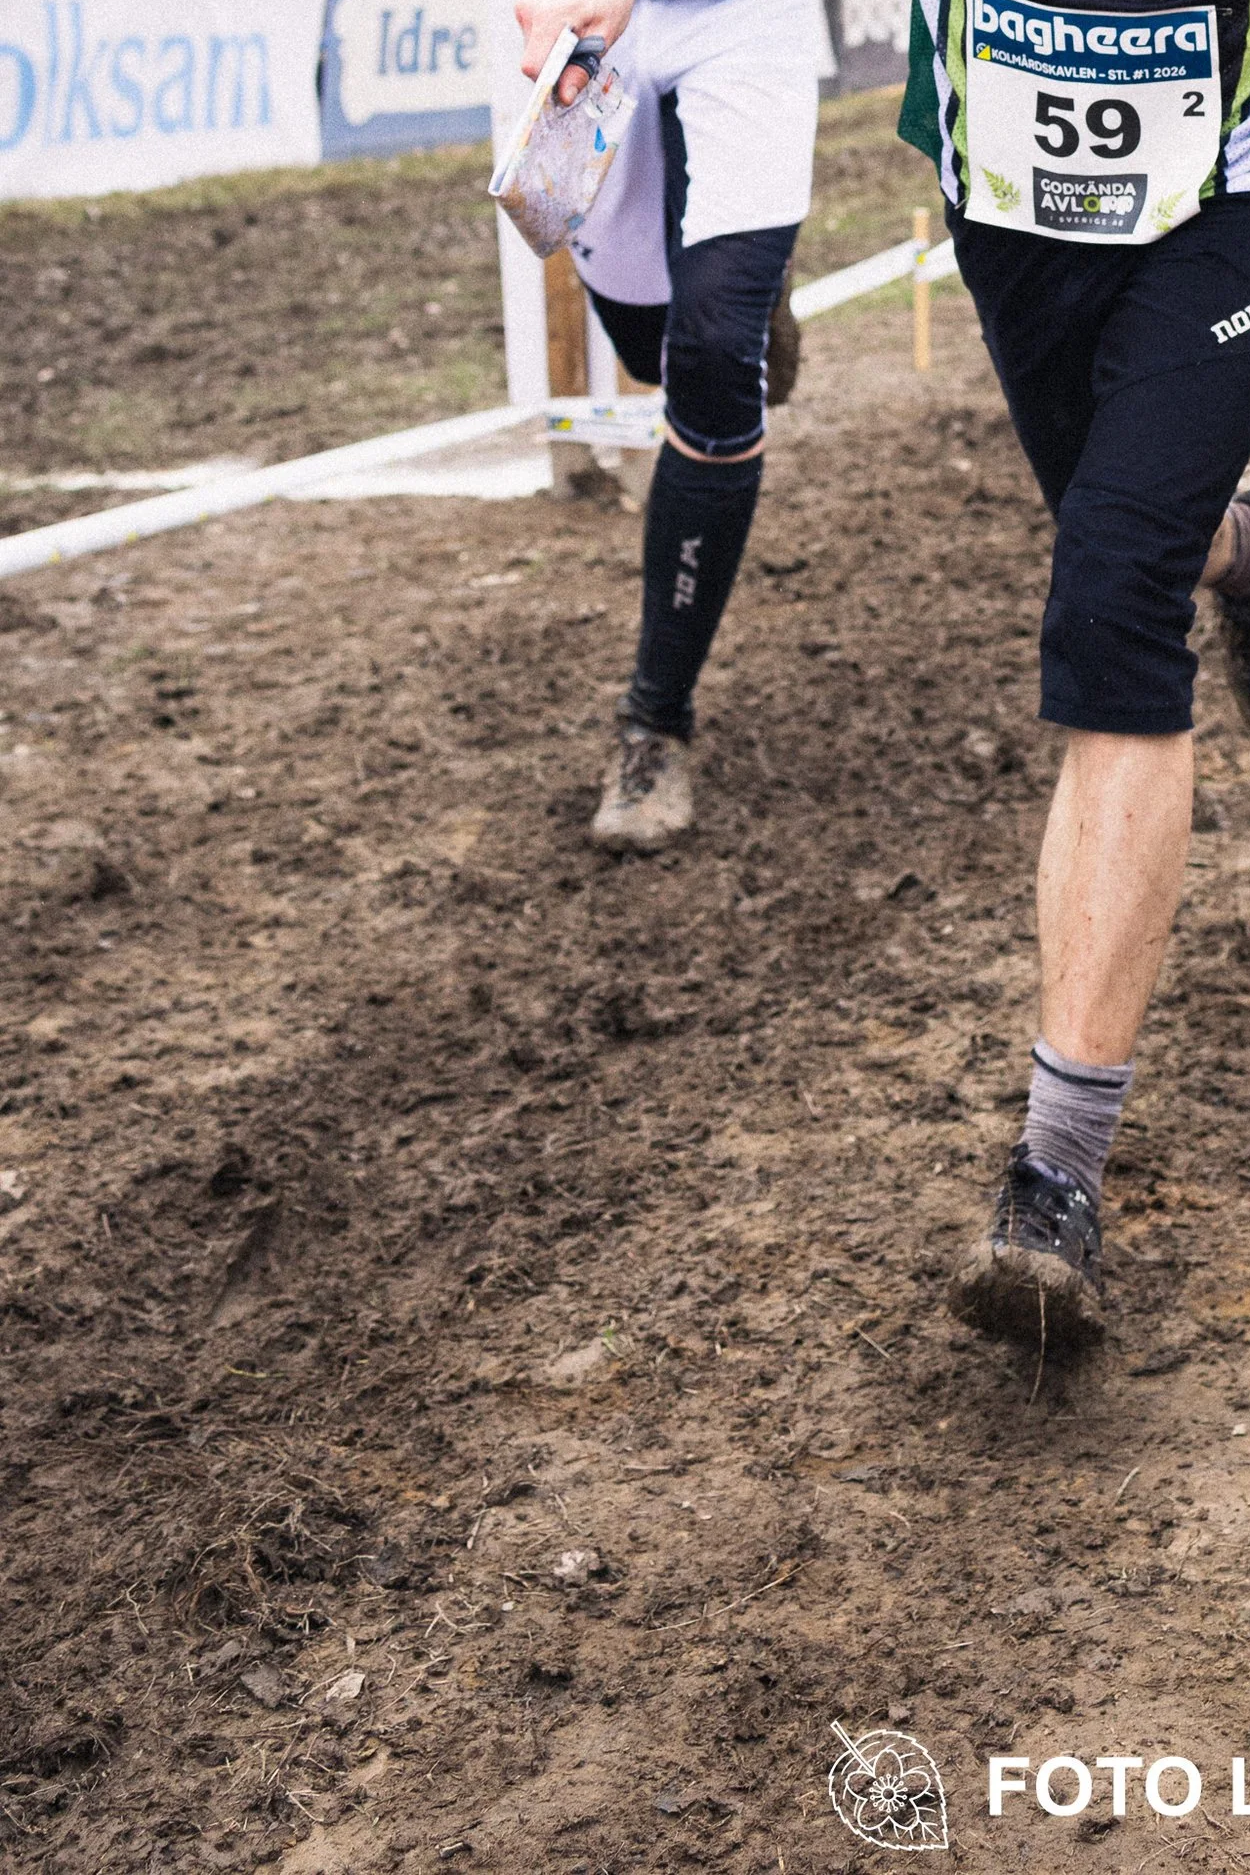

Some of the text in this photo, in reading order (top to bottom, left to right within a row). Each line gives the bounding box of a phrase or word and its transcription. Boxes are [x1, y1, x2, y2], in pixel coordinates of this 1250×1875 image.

[377, 7, 478, 77] Idre
[992, 49, 1097, 80] KOLMÅRDSKAVLEN
[1108, 69, 1130, 80] STL
[1133, 68, 1150, 80] #1
[1153, 66, 1187, 78] 2026
[1182, 91, 1205, 117] 2
[1033, 90, 1142, 159] 59
[1040, 178, 1137, 196] GODKÄNDA
